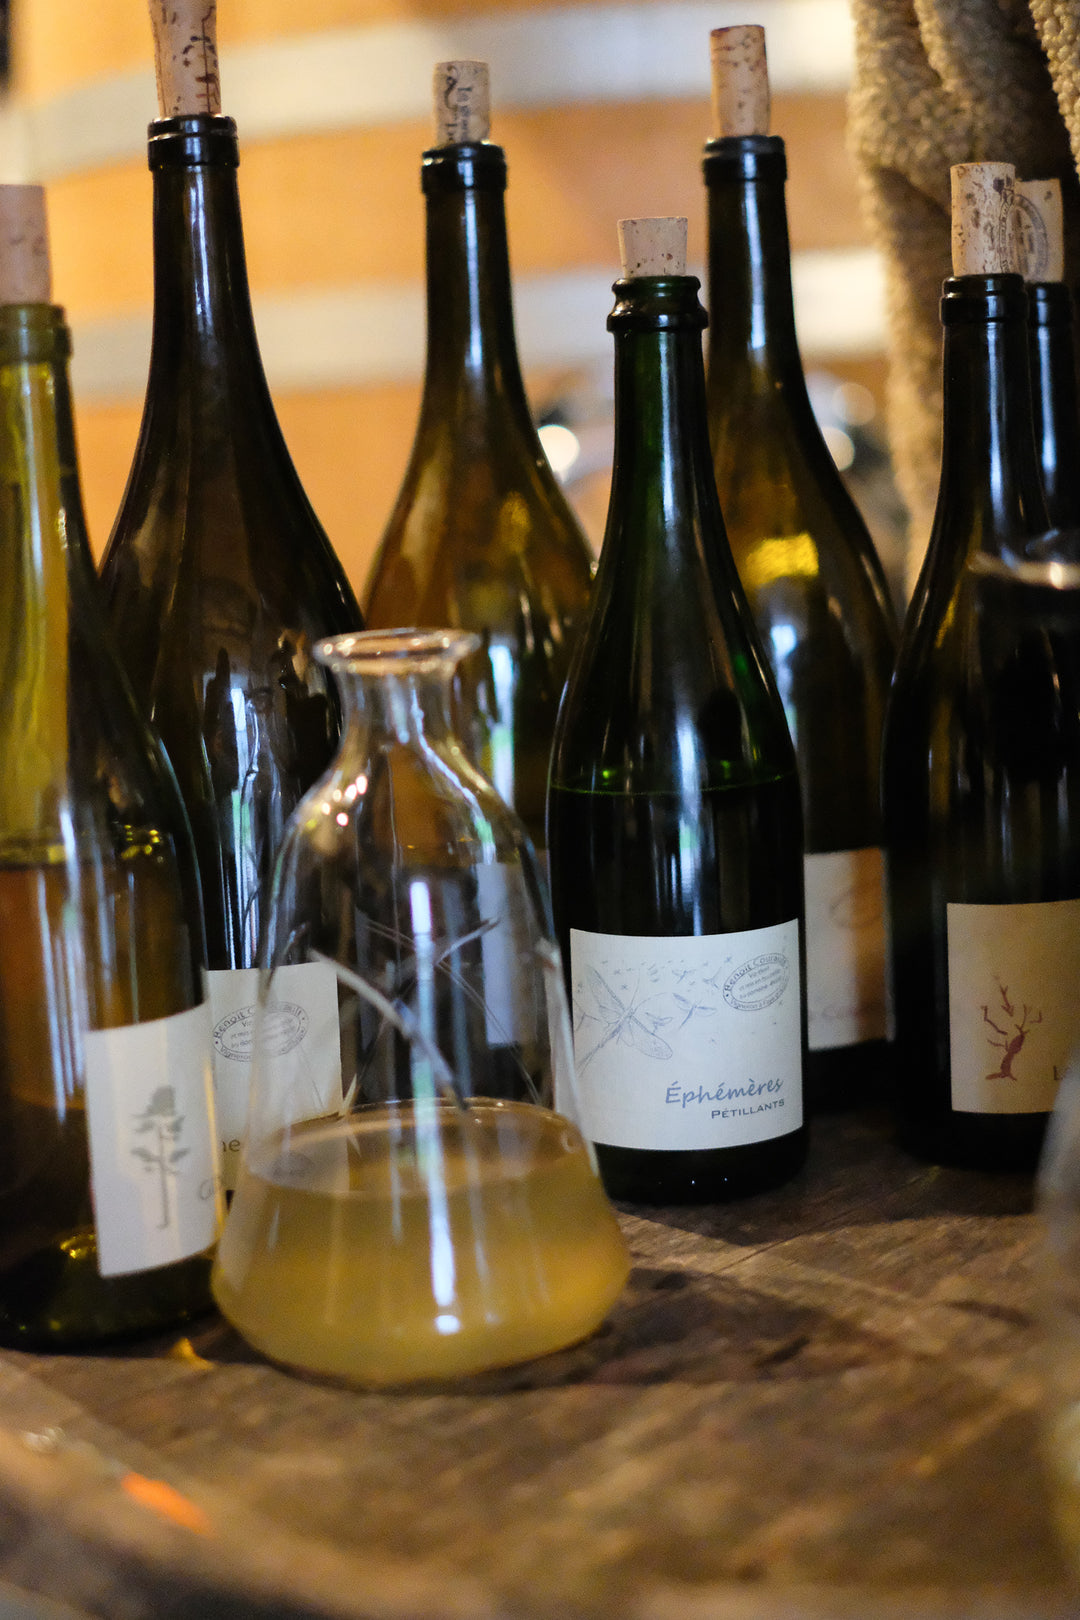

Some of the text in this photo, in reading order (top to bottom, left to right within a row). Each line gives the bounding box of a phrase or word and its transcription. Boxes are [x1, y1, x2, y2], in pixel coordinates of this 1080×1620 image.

[214, 1011, 246, 1039] Benoit
[665, 1078, 783, 1109] Éphémères
[711, 1098, 785, 1119] PÉTILLANTS
